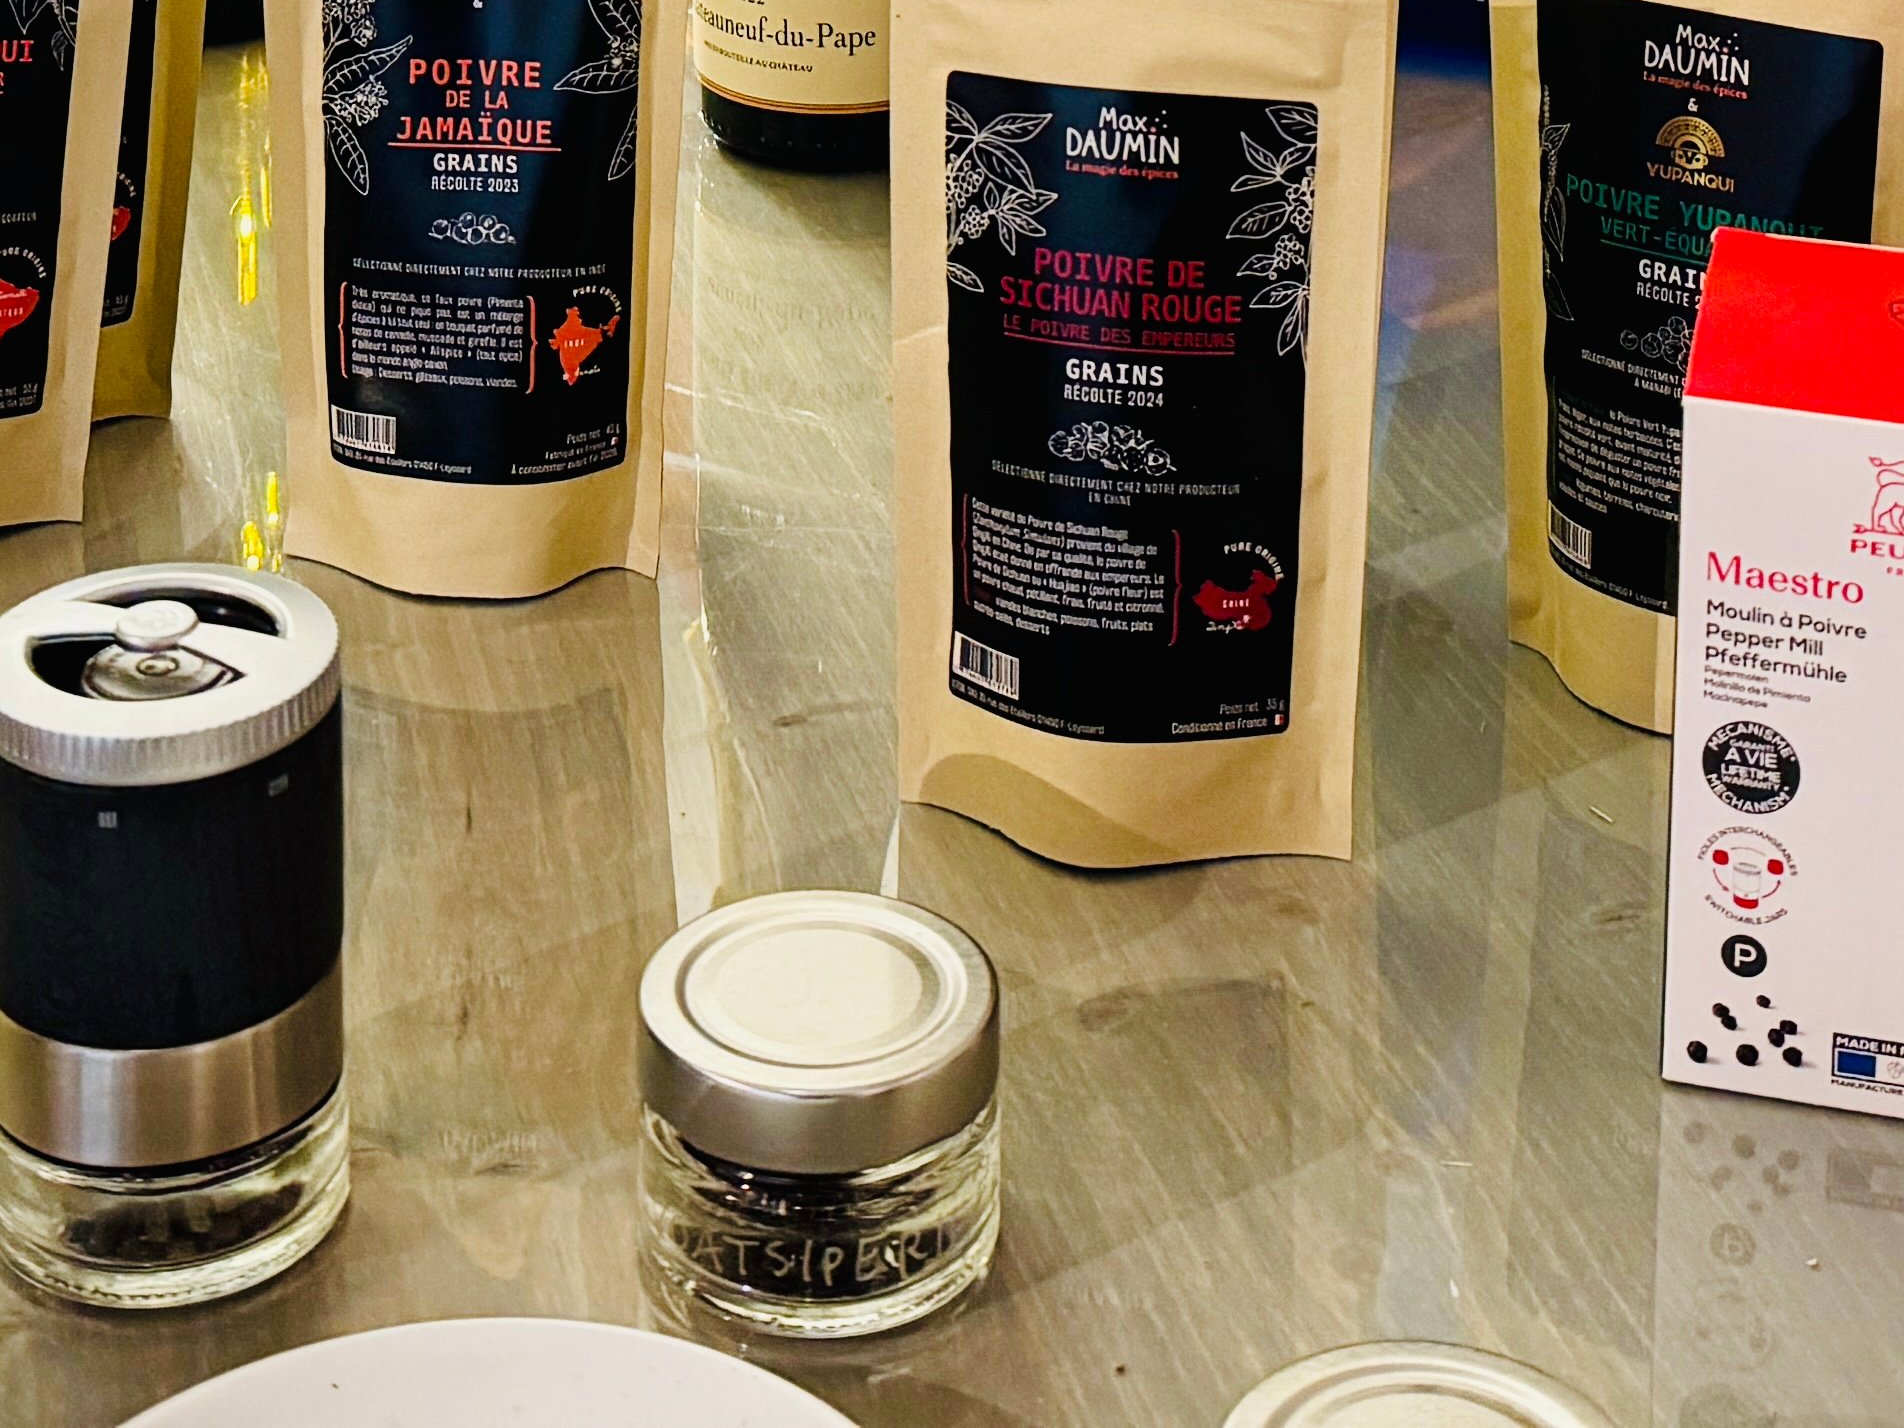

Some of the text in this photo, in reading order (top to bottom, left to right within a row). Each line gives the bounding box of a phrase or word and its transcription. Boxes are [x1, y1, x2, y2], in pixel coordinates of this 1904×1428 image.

[1675, 23, 1720, 52] Max
[409, 58, 542, 88] POIVRE
[1644, 40, 1750, 86] DAUMIN
[446, 90, 509, 110] DE LA
[1692, 78, 1711, 92] des
[1713, 83, 1748, 101] épices
[1098, 106, 1147, 131] Max
[1687, 97, 1698, 112] &
[396, 112, 552, 148] JAMAÏQUE
[1066, 126, 1179, 165] DAUMIN
[433, 153, 518, 174] GRAINS
[1119, 163, 1140, 176] des
[1646, 162, 1735, 193] YUPANQUI
[431, 176, 519, 193] RÉCOLTE 2023
[1567, 173, 1660, 220] POIVRE
[1600, 215, 1712, 257] VERT-ÉQU
[1034, 247, 1205, 289] POIVRE DE
[1638, 259, 1707, 291] GRAI
[1000, 276, 1242, 323] SICHUAN ROUGE
[1636, 281, 1690, 307] RÉCOLTE
[1004, 313, 1022, 331] LE
[1031, 318, 1091, 341] POIVRE
[1100, 327, 1131, 344] DES
[1065, 358, 1164, 386] GRAINS
[1064, 383, 1164, 408] RÉCOLTE 2024
[1145, 483, 1175, 495] NOTRE
[1707, 551, 1864, 604] Maestro
[1707, 599, 1867, 639] Moulin à Poivre
[1706, 623, 1824, 656] Pepper Mill
[1705, 645, 1847, 683] Pfeffermühle
[1724, 747, 1778, 769] A VIE
[1720, 763, 1782, 784] LIFETIME
[1706, 773, 1791, 813] MECHANISM
[1733, 942, 1757, 968] P
[1836, 1036, 1879, 1053] MADE
[1881, 1043, 1897, 1055] IN
